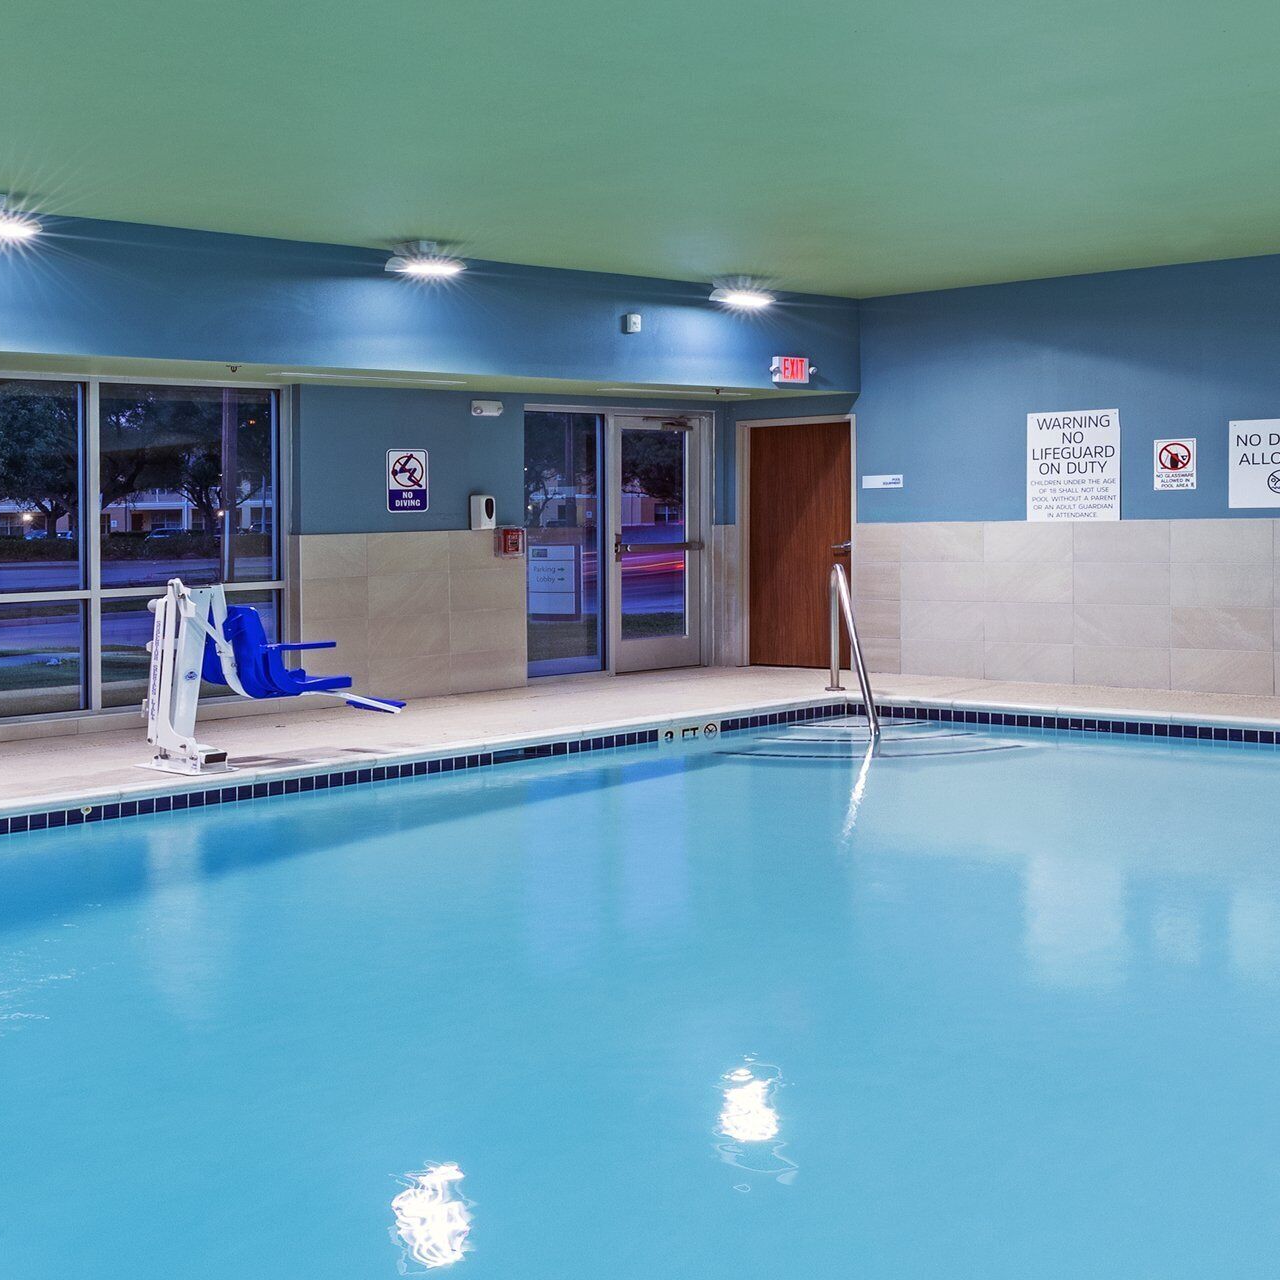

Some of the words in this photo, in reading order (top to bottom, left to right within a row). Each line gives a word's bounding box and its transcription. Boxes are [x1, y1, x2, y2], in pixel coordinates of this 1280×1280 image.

[783, 358, 805, 379] EXIT
[1037, 415, 1110, 430] WARNING
[1062, 431, 1084, 444] NO
[1236, 433, 1261, 447] NO
[1032, 445, 1115, 460] LIFEGUARD
[1039, 462, 1060, 475] ON
[1067, 461, 1107, 474] DUTY
[402, 491, 413, 499] NO
[395, 499, 421, 507] DIVING
